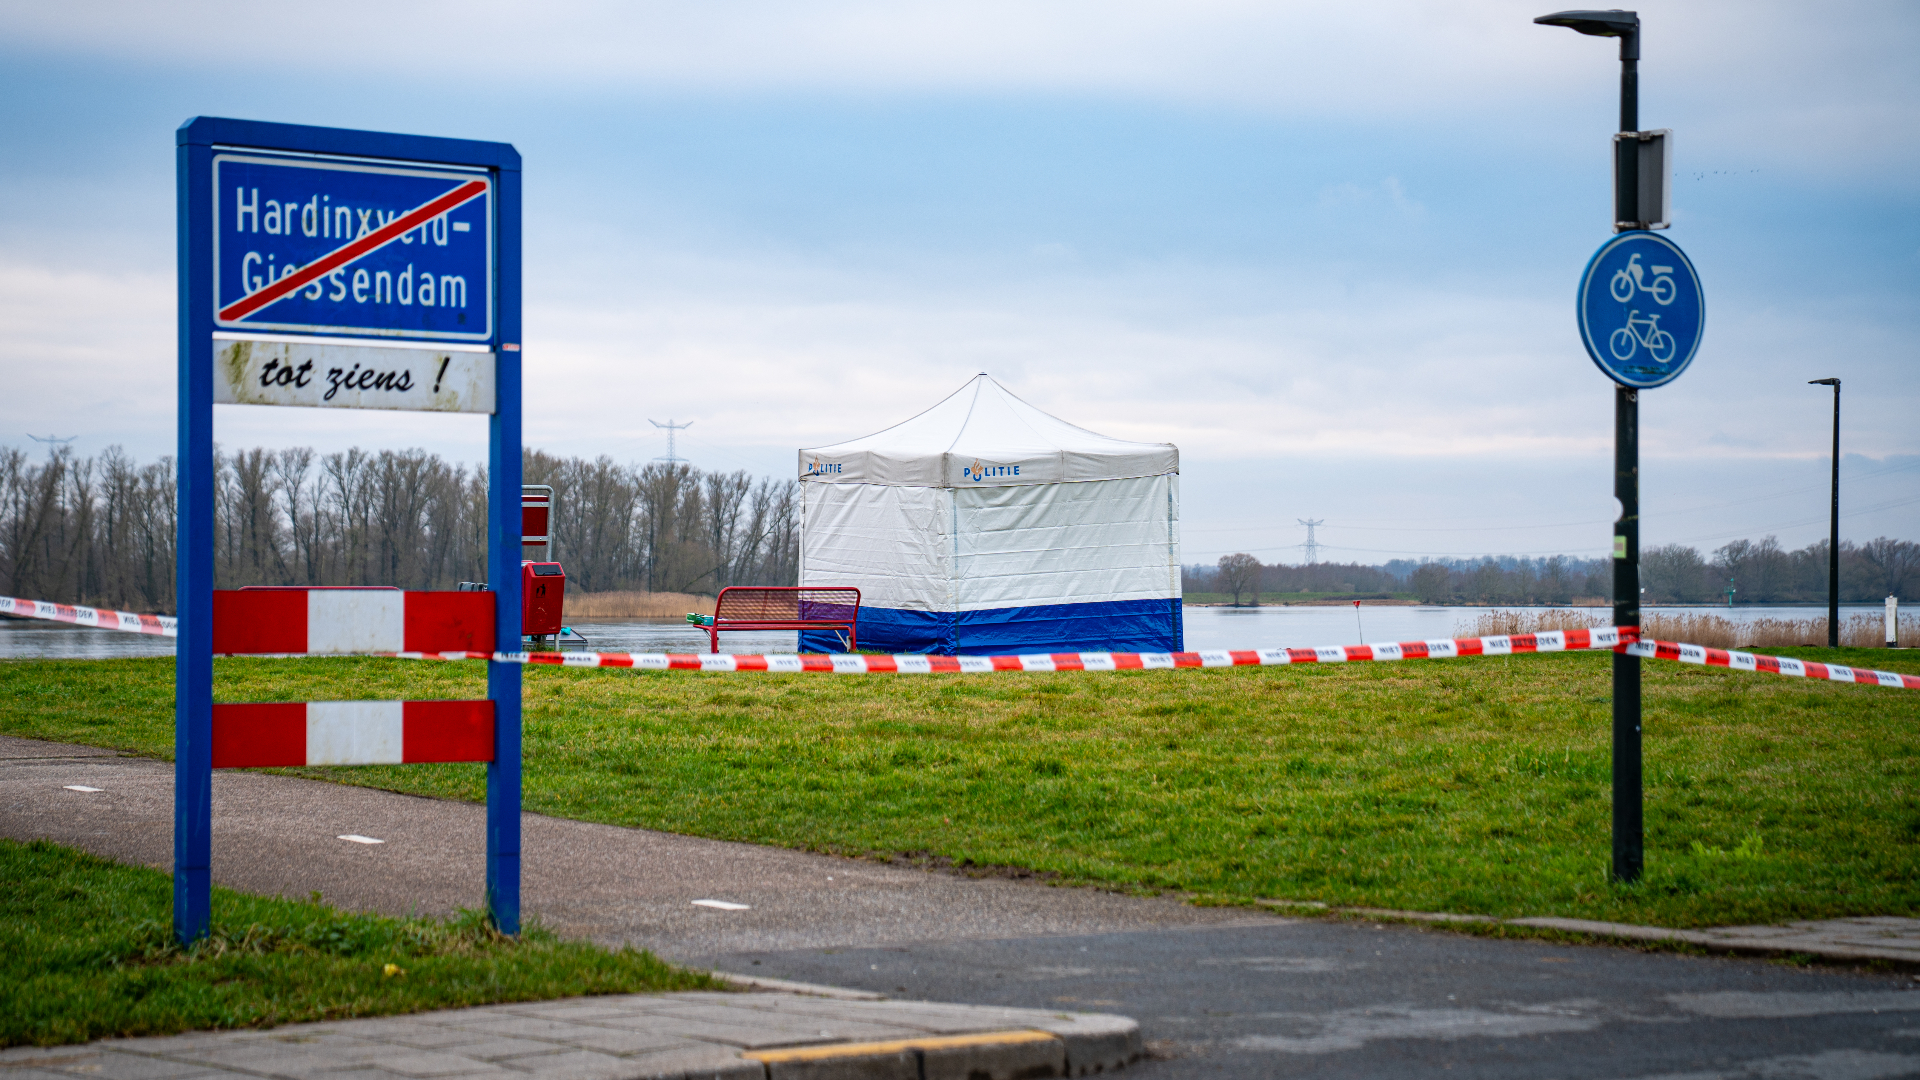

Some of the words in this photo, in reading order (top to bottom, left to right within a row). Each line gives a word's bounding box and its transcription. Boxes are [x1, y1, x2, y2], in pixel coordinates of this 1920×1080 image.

[241, 251, 467, 308] Giessendam
[259, 357, 313, 388] tot
[323, 363, 415, 401] ziens
[808, 463, 842, 476] POLITIE
[964, 465, 1020, 482] POLITIE
[1489, 638, 1509, 648] NIET
[1635, 640, 1655, 651] NIET
[1735, 654, 1754, 665] NIET
